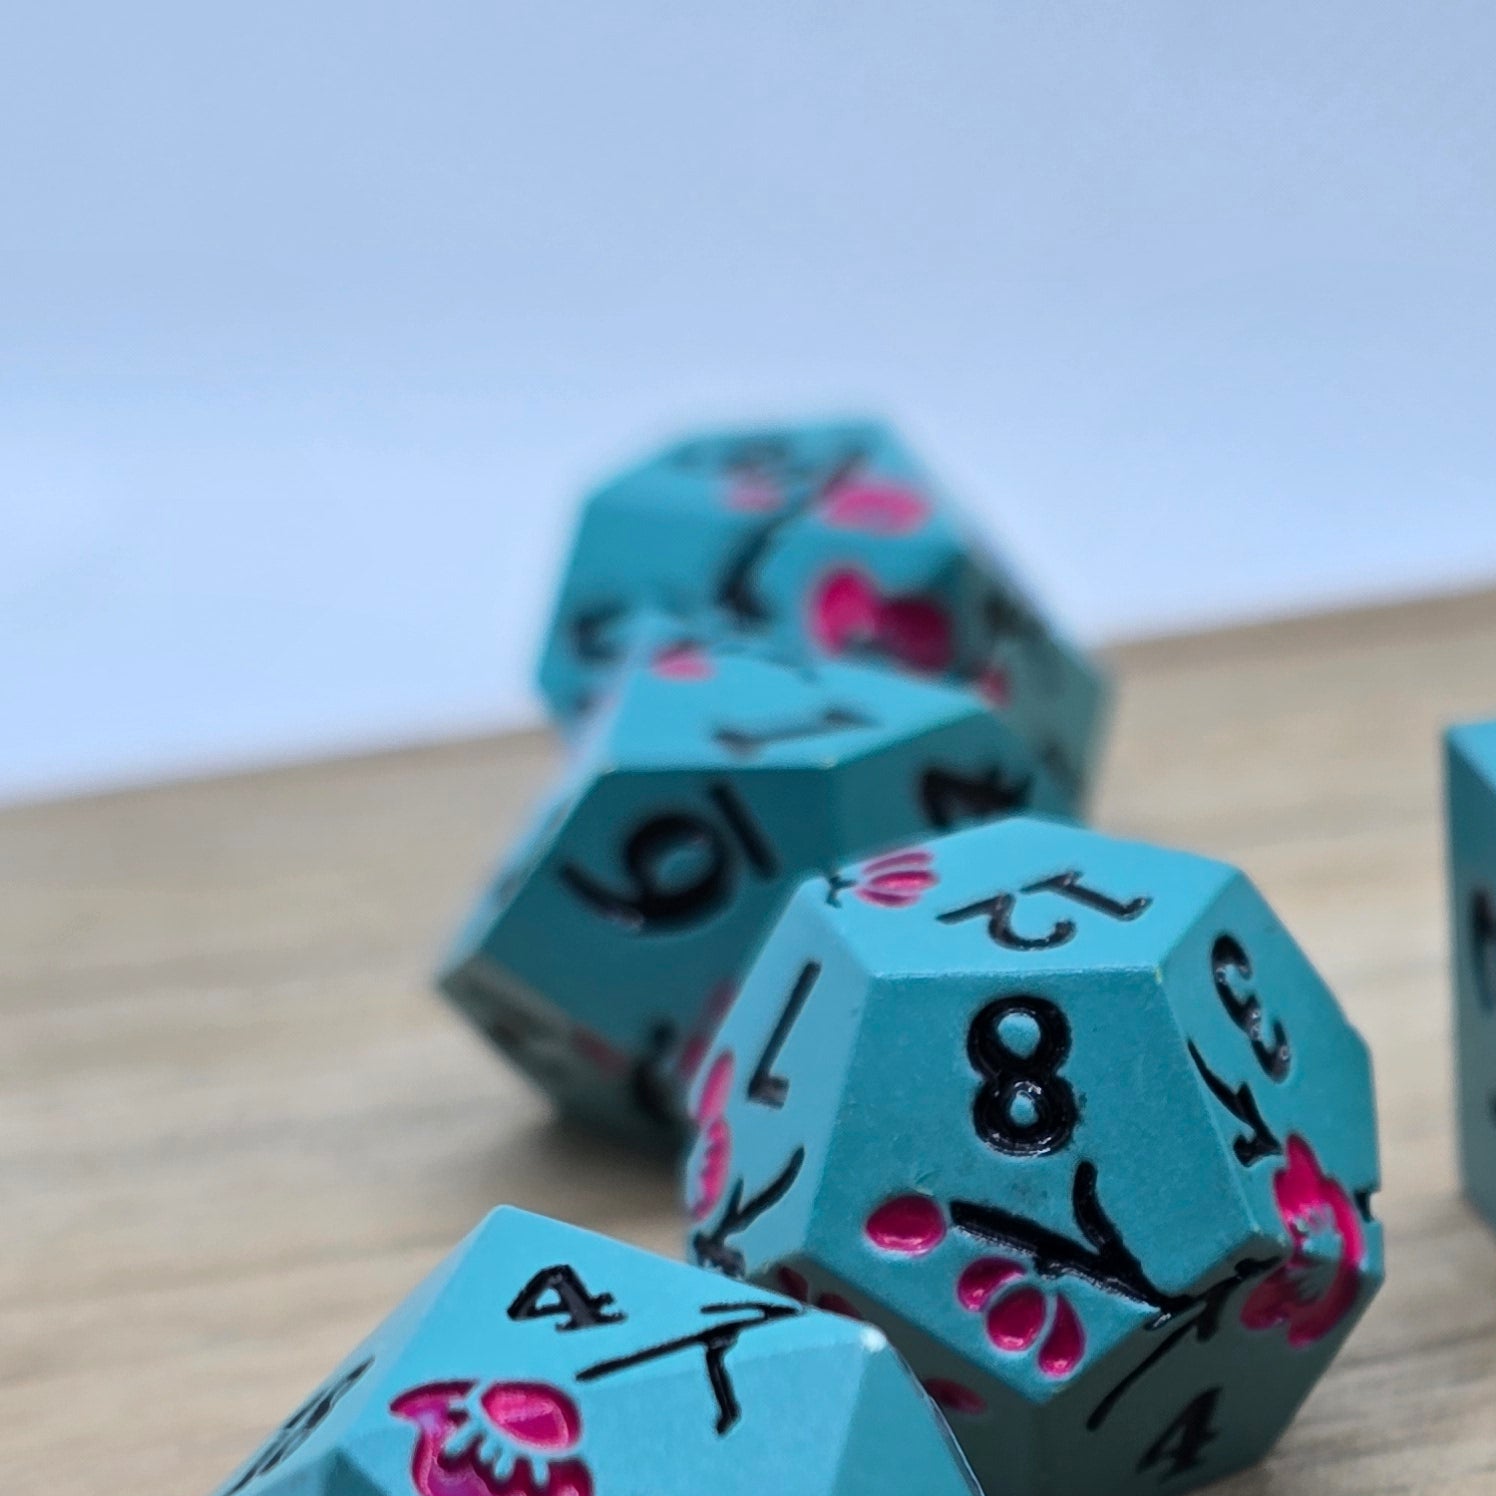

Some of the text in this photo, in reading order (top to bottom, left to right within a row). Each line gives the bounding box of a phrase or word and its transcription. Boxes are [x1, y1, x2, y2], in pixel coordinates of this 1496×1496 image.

[935, 870, 1154, 952] 12
[1210, 933, 1291, 1083] 3
[966, 995, 1084, 1158] 8
[507, 1263, 630, 1333] 4
